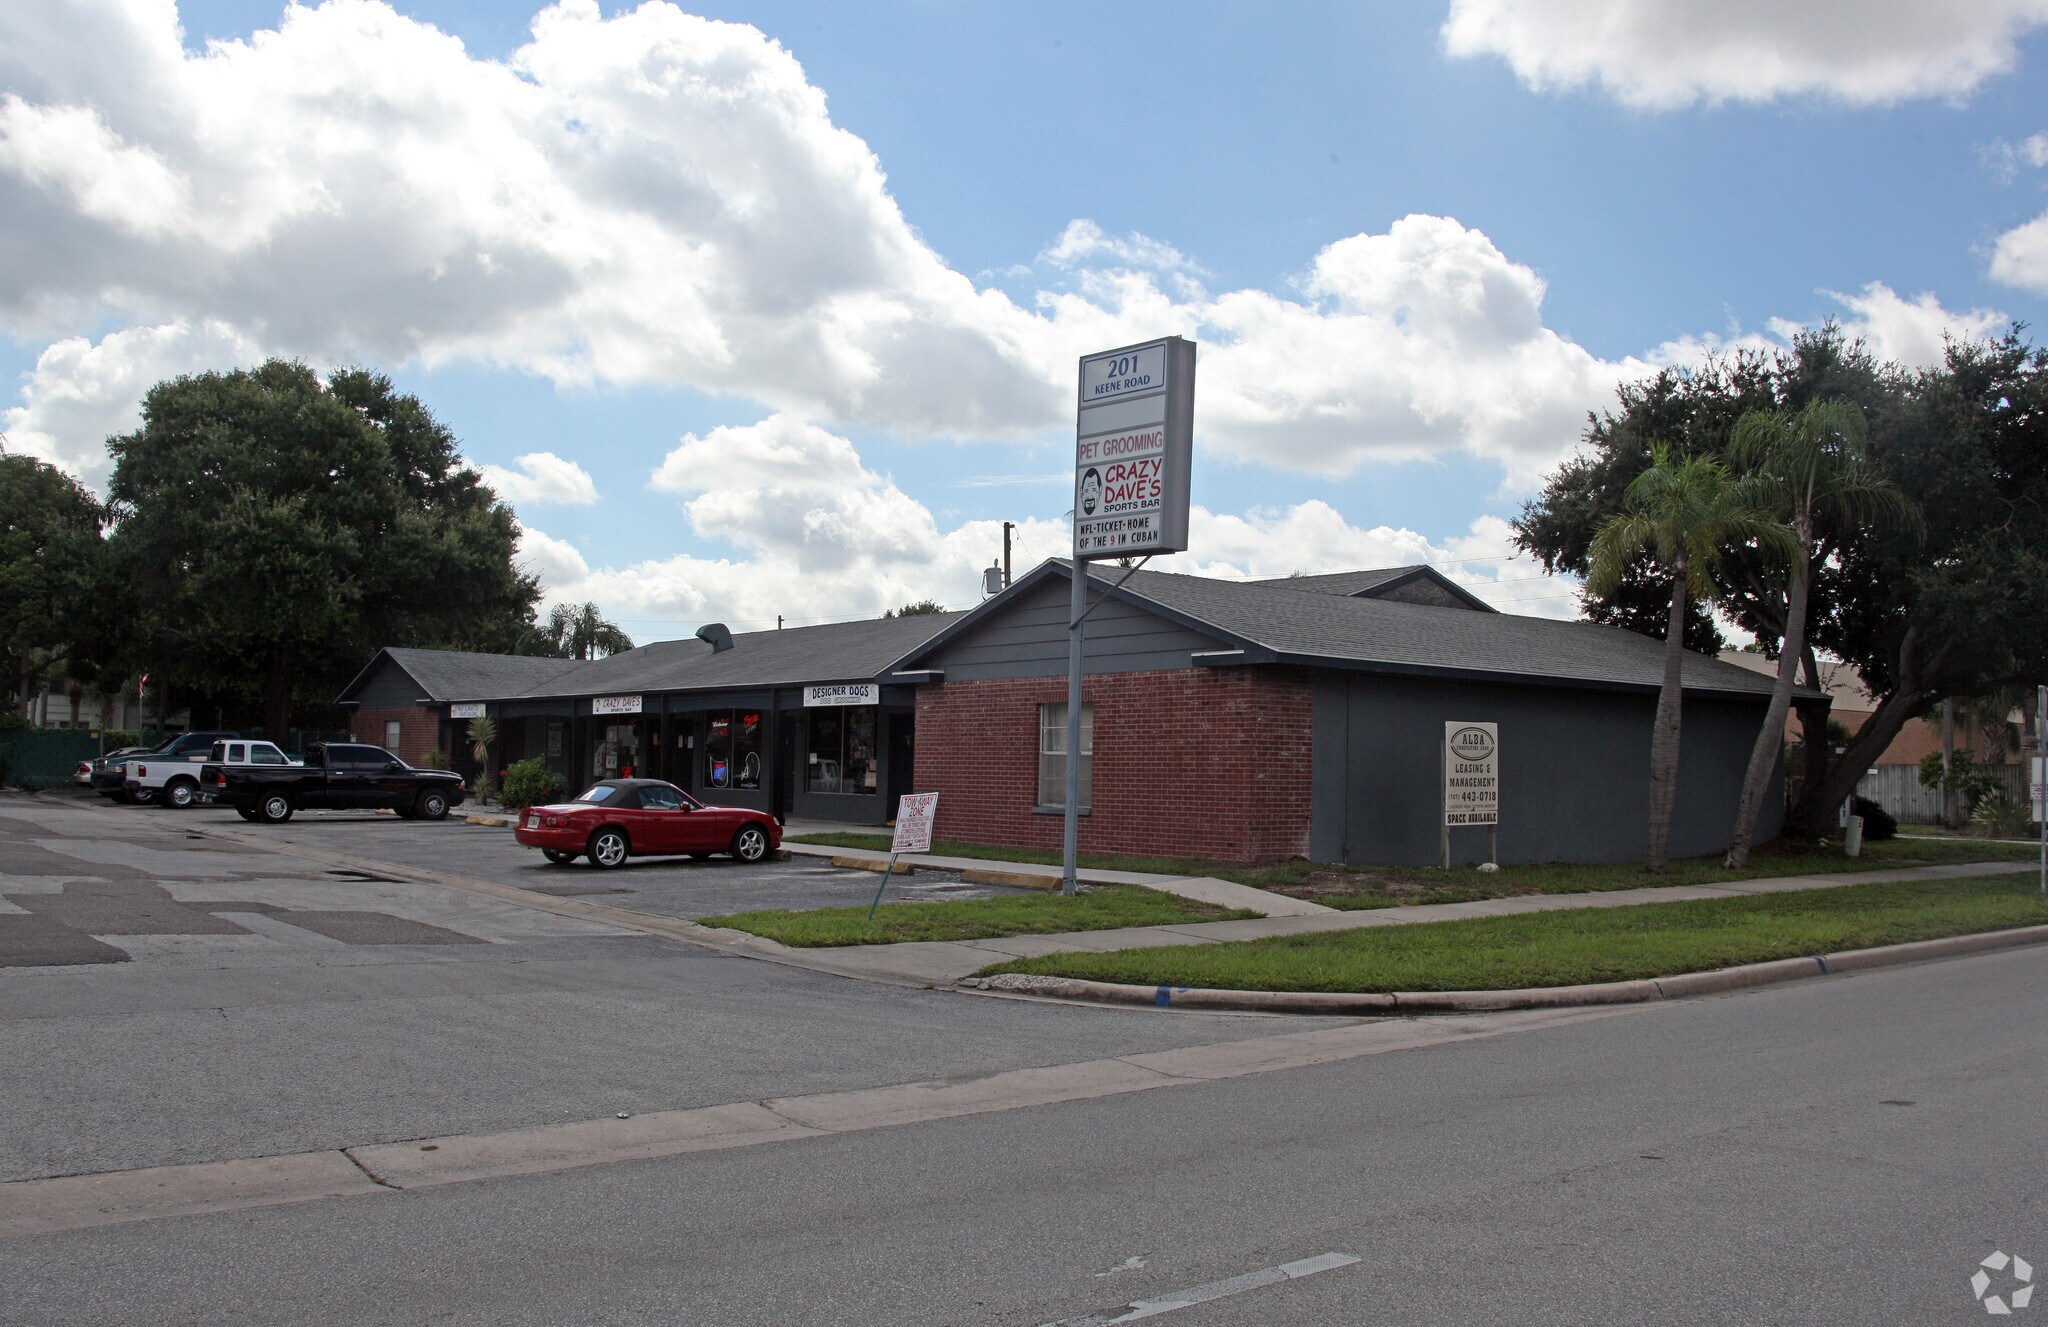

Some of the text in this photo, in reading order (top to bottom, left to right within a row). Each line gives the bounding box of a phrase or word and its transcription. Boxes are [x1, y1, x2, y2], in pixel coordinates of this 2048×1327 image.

[1108, 355, 1138, 378] 201
[1095, 375, 1150, 395] KEENE ROAD
[1080, 431, 1162, 460] PET GROOMING
[1105, 458, 1162, 484] CRAZY
[1104, 480, 1161, 504] DAVE'S
[1104, 499, 1160, 513] SPORTS BAR
[1079, 530, 1158, 548] OF THE 9 IN CUBAN
[812, 685, 869, 699] DESIGNER DOGS
[603, 698, 620, 708] CRAZY
[834, 696, 861, 704] GROOMING
[1462, 734, 1485, 745] ALBA
[1455, 763, 1491, 773] LEASING &
[1449, 778, 1495, 787] MANAGEMENT
[904, 796, 933, 807] TOW AWAY
[1462, 791, 1496, 801] 443-0718
[909, 806, 925, 817] ZONE
[1447, 813, 1496, 824] SPACE AVAILABLE
